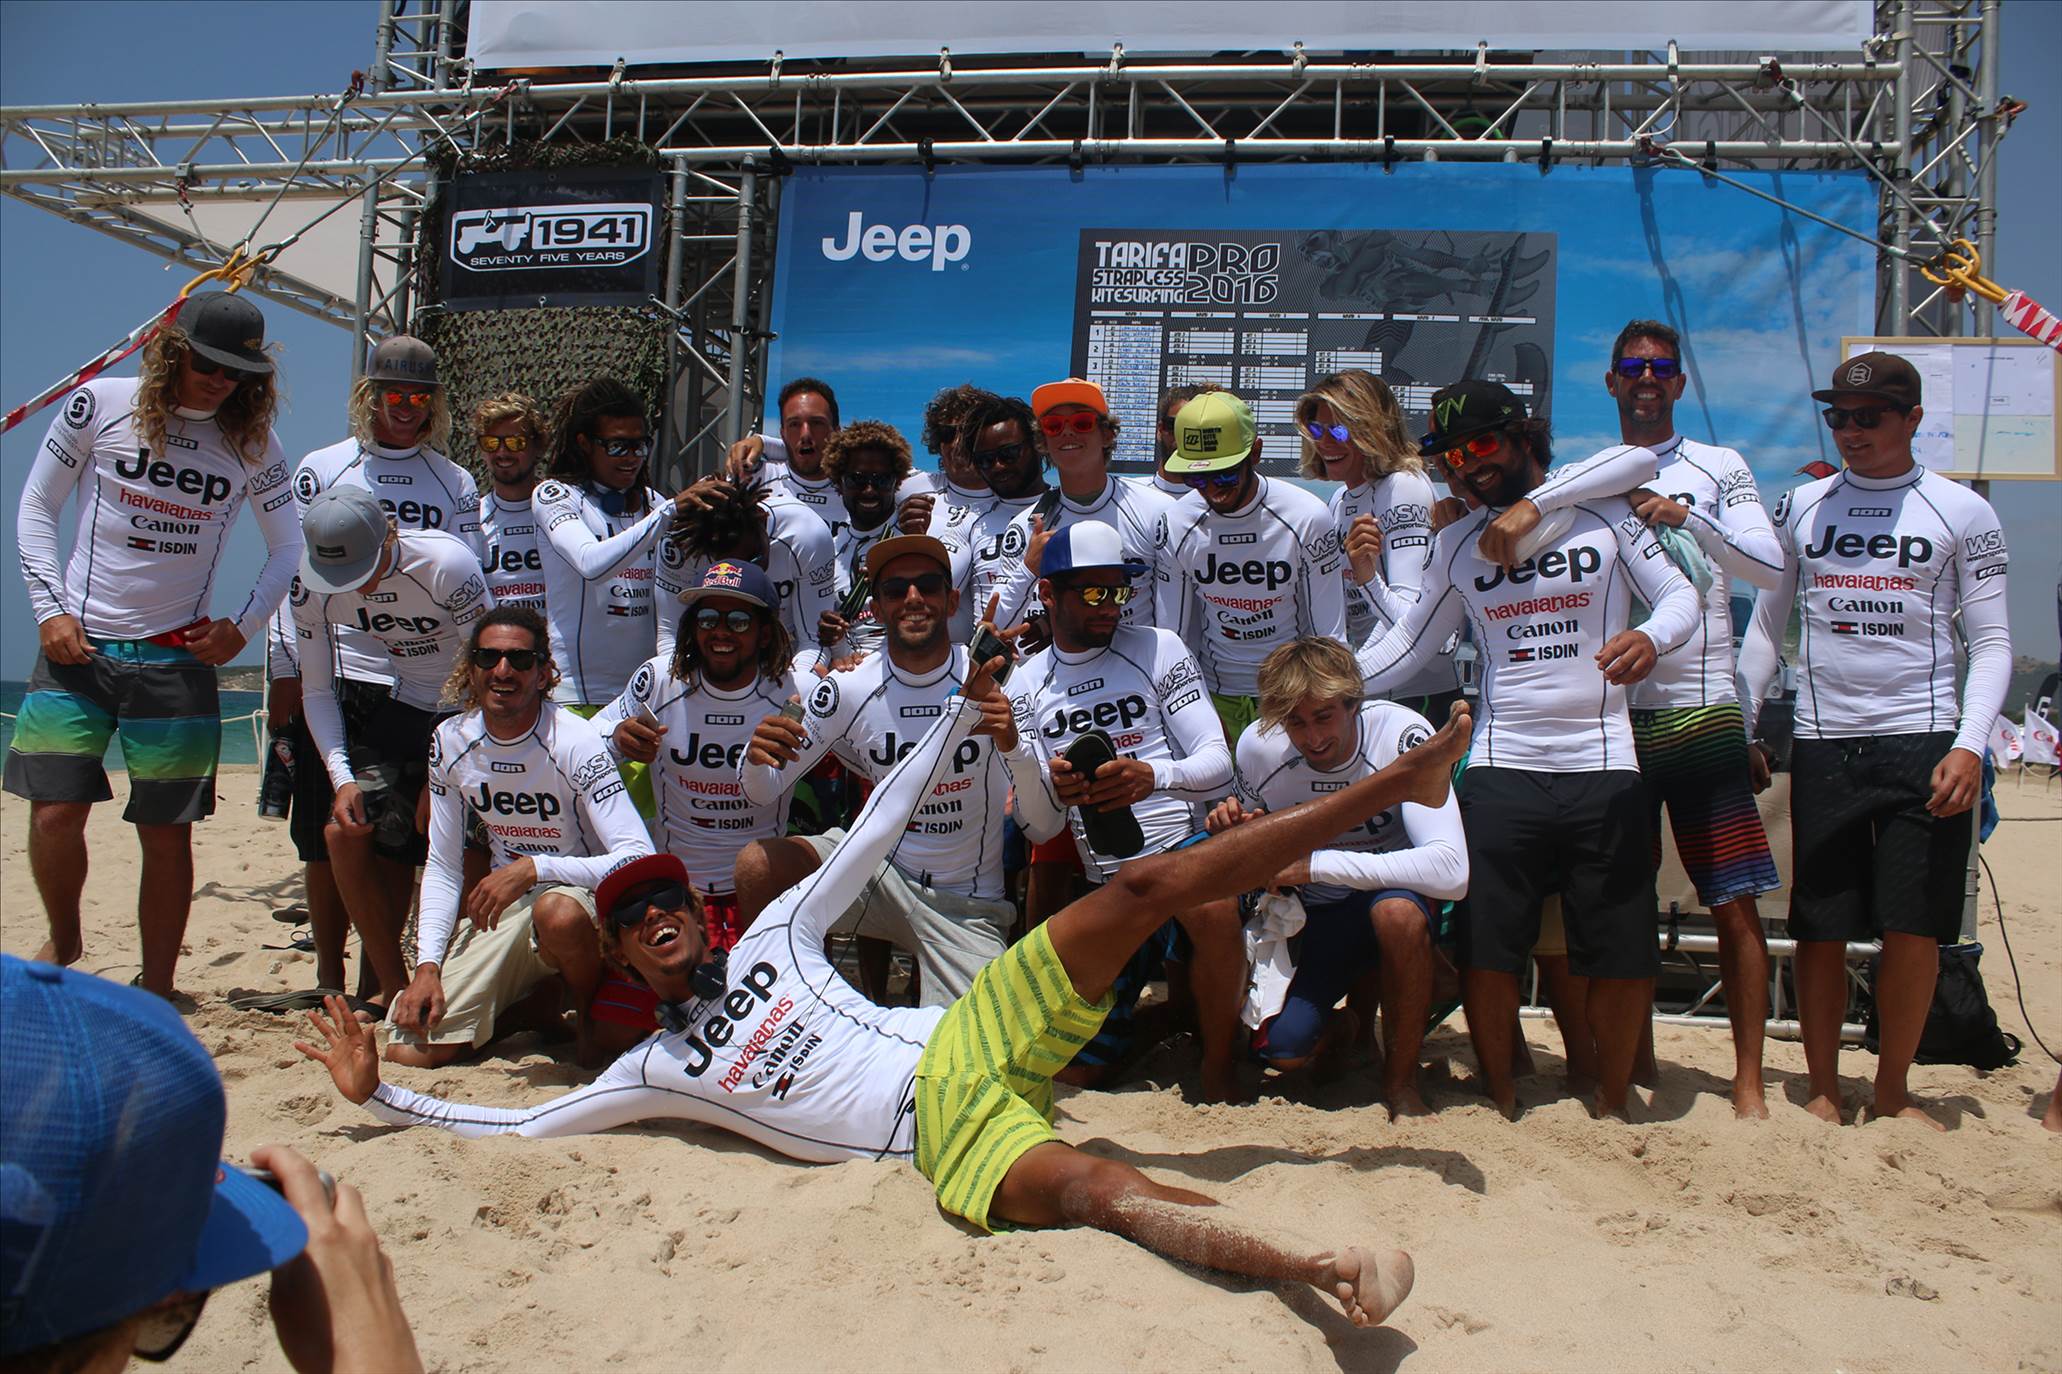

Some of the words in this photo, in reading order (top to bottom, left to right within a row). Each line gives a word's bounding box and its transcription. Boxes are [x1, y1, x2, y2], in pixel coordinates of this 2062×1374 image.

[538, 217, 636, 246] 1941
[822, 211, 972, 272] Jeep
[470, 254, 533, 266] SEVENTY
[539, 253, 569, 263] FIVE
[576, 251, 625, 262] YEARS
[1095, 241, 1187, 268] TARIFA
[1187, 242, 1280, 275] PRO
[1093, 269, 1184, 286] STRAPLESS
[1185, 274, 1278, 305] 2016
[1091, 287, 1184, 303] KITESURFING
[115, 447, 232, 505] Jeep
[120, 488, 213, 521] havaianas
[379, 499, 443, 530] eep
[130, 515, 200, 535] Canon
[158, 541, 198, 555] ISDIN
[482, 545, 543, 574] Jee
[1805, 524, 1933, 568] Jeep
[1194, 553, 1292, 591] Jeep
[1474, 545, 1601, 592] Jeep
[1813, 572, 1915, 592] havaianas
[1216, 608, 1274, 625] Canon
[1484, 591, 1592, 622] havaianas
[1828, 596, 1904, 614] Canon
[350, 607, 441, 635] Jeep
[1242, 625, 1276, 641] ISDIN
[1506, 620, 1579, 640] Canon
[1862, 622, 1904, 637] ISDIN
[407, 643, 440, 657] ISDIN
[1538, 643, 1579, 660] ISDIN
[1043, 694, 1147, 739] Jeep
[670, 733, 743, 769] Jee
[469, 782, 561, 822] Jeep
[718, 815, 754, 829] ISDIN
[925, 819, 963, 834] ISDIN
[683, 961, 778, 1078] Jeep
[717, 996, 795, 1093] havaianas
[752, 1019, 804, 1089] Canon
[789, 1033, 823, 1072] ISDIN
